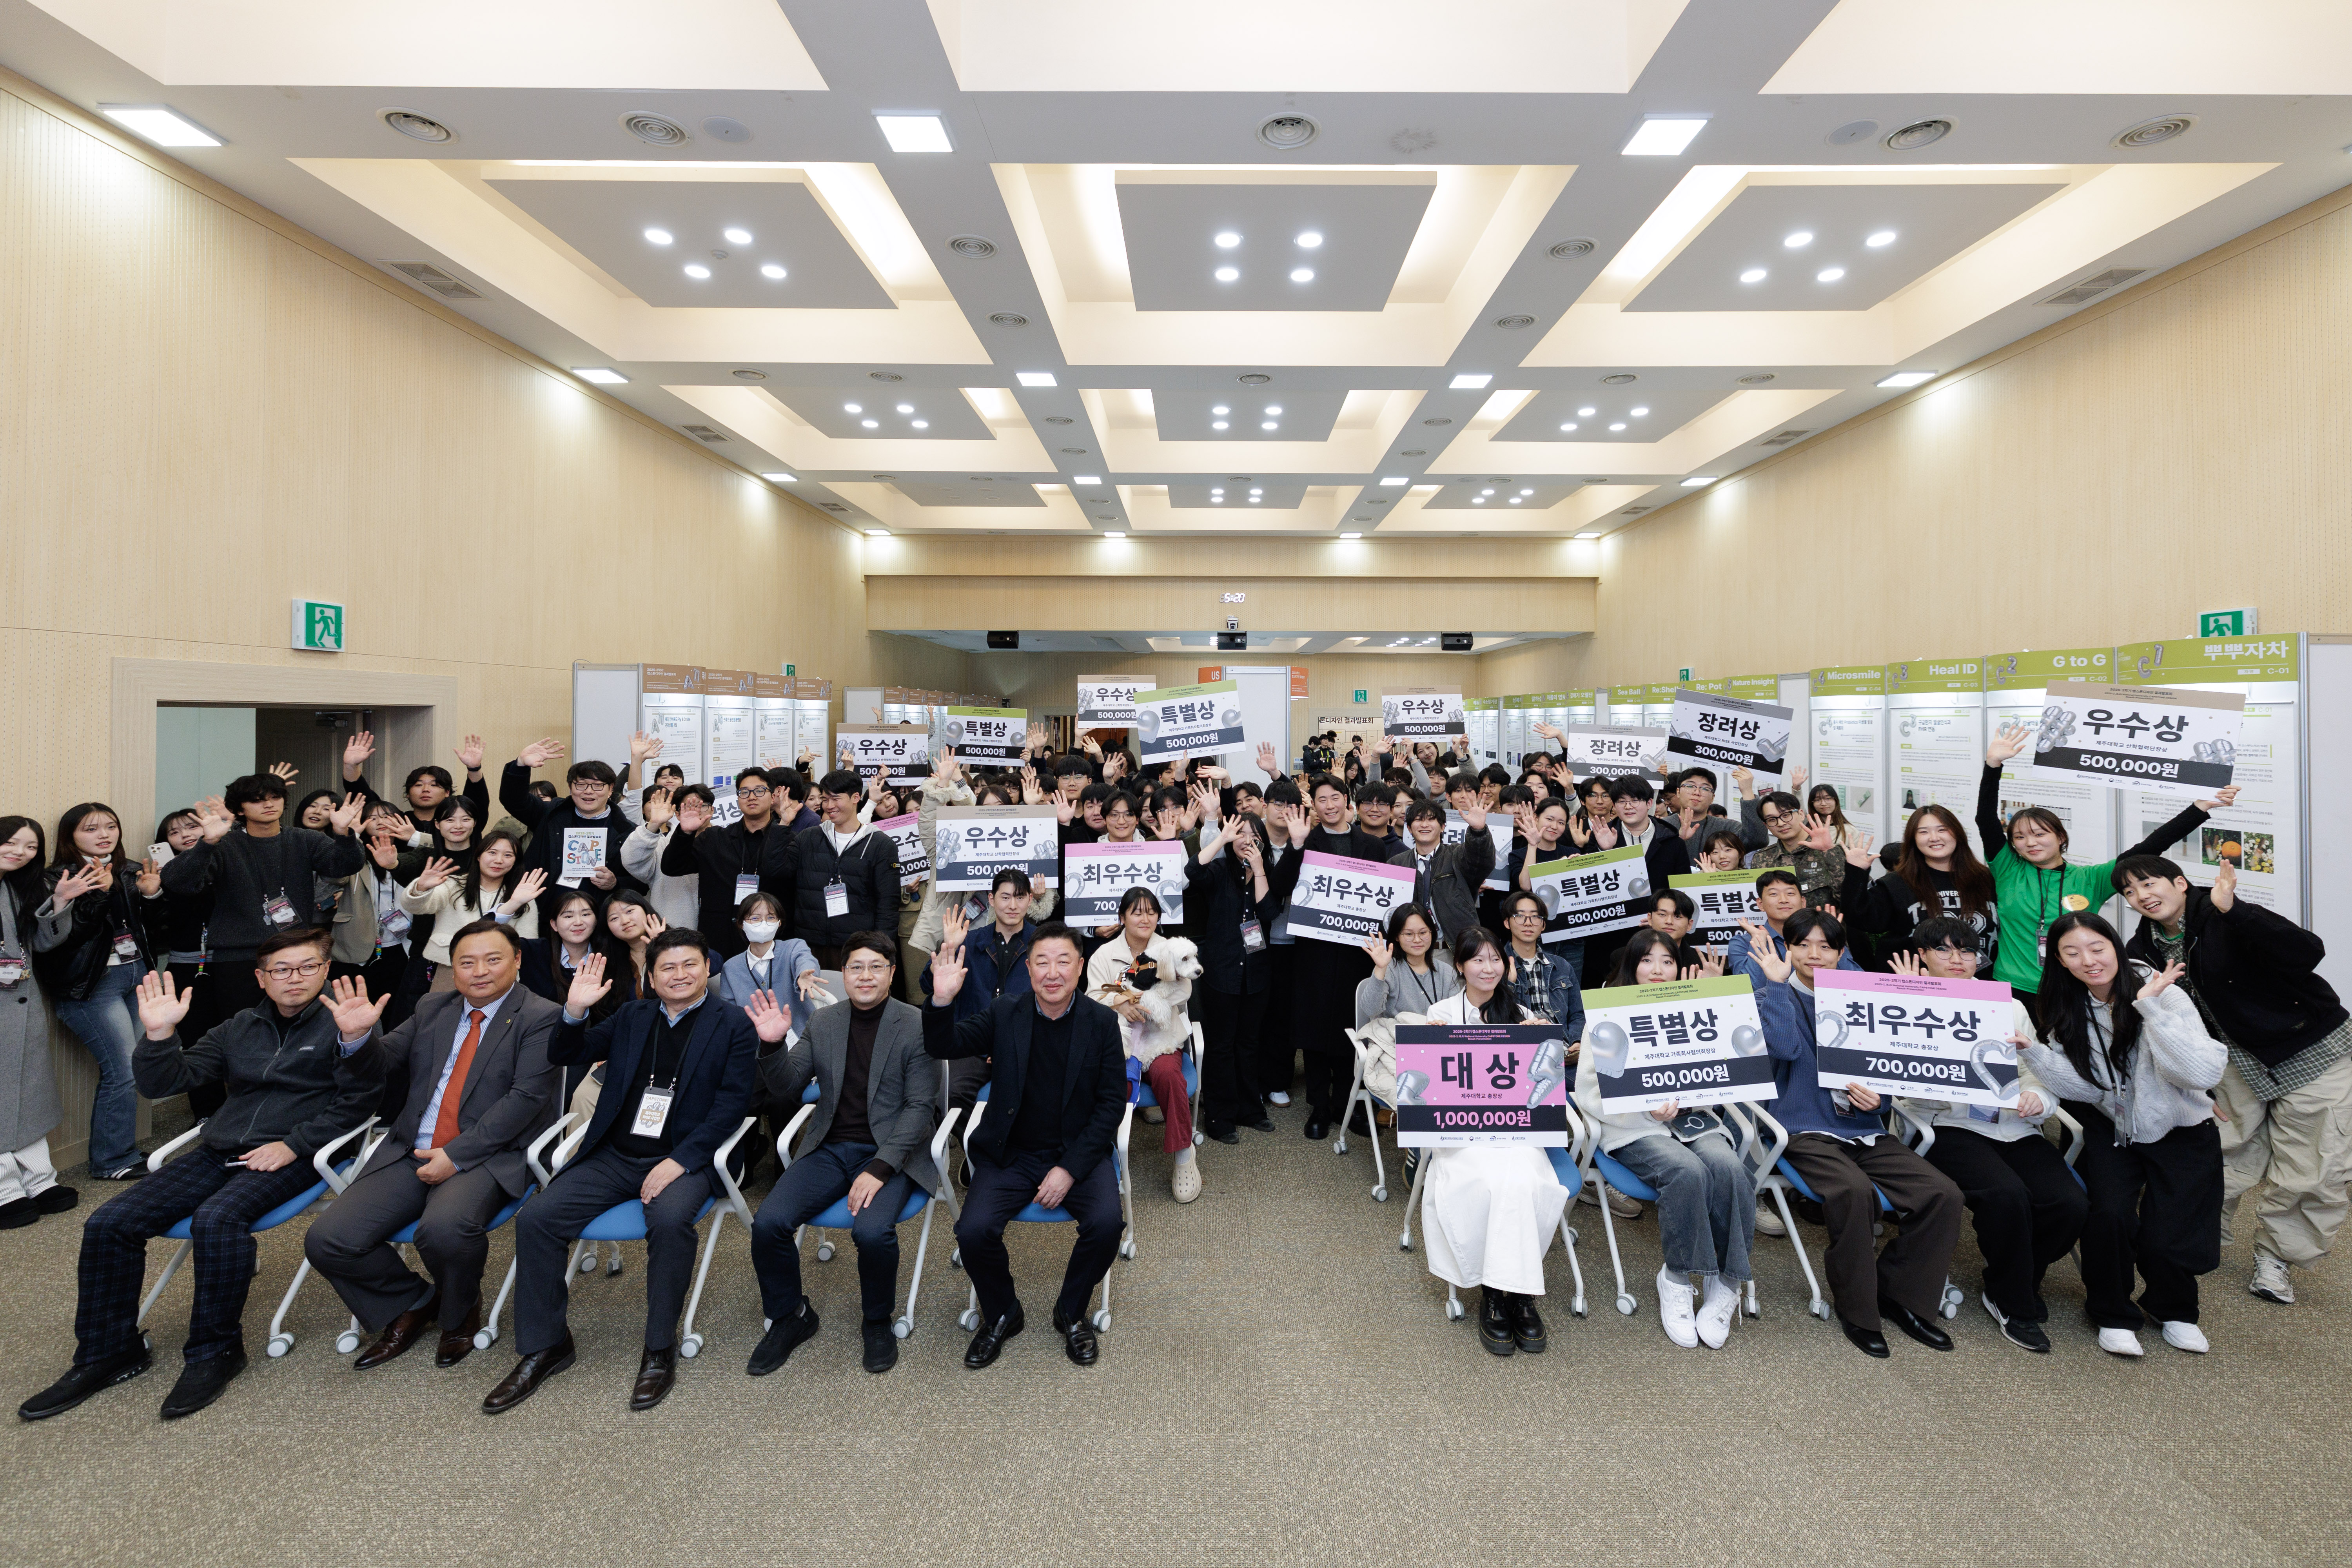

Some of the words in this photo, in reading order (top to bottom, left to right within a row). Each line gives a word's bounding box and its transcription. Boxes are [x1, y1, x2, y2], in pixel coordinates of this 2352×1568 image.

[1225, 593, 1245, 603] 5:20
[2053, 656, 2066, 667] G
[2071, 655, 2088, 667] to
[2092, 654, 2106, 666] G
[2203, 641, 2289, 661] 뿌뿌자차
[1211, 671, 1220, 680] US
[1828, 670, 1880, 680] Microsmile
[1929, 665, 1959, 675] Heal
[1963, 664, 1978, 674] ID
[1096, 688, 1138, 701] 우수상
[1161, 700, 1215, 724] 특별상
[1402, 699, 1444, 715] 우수상
[965, 721, 1007, 737] 특별상
[1405, 724, 1446, 734] 500,000원
[1698, 712, 1760, 740] 장려상
[2083, 709, 2189, 742] 우수상
[858, 739, 907, 755] 우수상
[1166, 732, 1218, 748] 500,000원
[1590, 740, 1641, 757] 장려상
[2126, 743, 2167, 752] 산학협력단장상
[966, 747, 1005, 756] 500,000원
[1695, 745, 1754, 766] 300,000원
[1590, 766, 1639, 776] 300,000원
[2080, 754, 2180, 778] 500,000원
[710, 800, 743, 821] 려상
[965, 826, 1029, 849] 우수상
[1083, 862, 1163, 885] 최우수상
[1313, 875, 1394, 907] 최우수상
[1561, 869, 1620, 898] 특별상
[1588, 895, 1617, 904] 가족회사협의회장상
[1568, 904, 1626, 924] 500,000원
[1319, 914, 1379, 934] 700,000원
[1629, 1009, 1718, 1047] 특별상
[1846, 1002, 1981, 1042] 최우수상
[1671, 1048, 1716, 1057] 가족회사협의회장상
[1441, 1052, 1473, 1090] 대
[1485, 1052, 1519, 1089] 상
[1641, 1064, 1730, 1088] 500,000원
[1866, 1057, 1967, 1082] 700,000원
[1434, 1110, 1531, 1129] 1,000,000원
